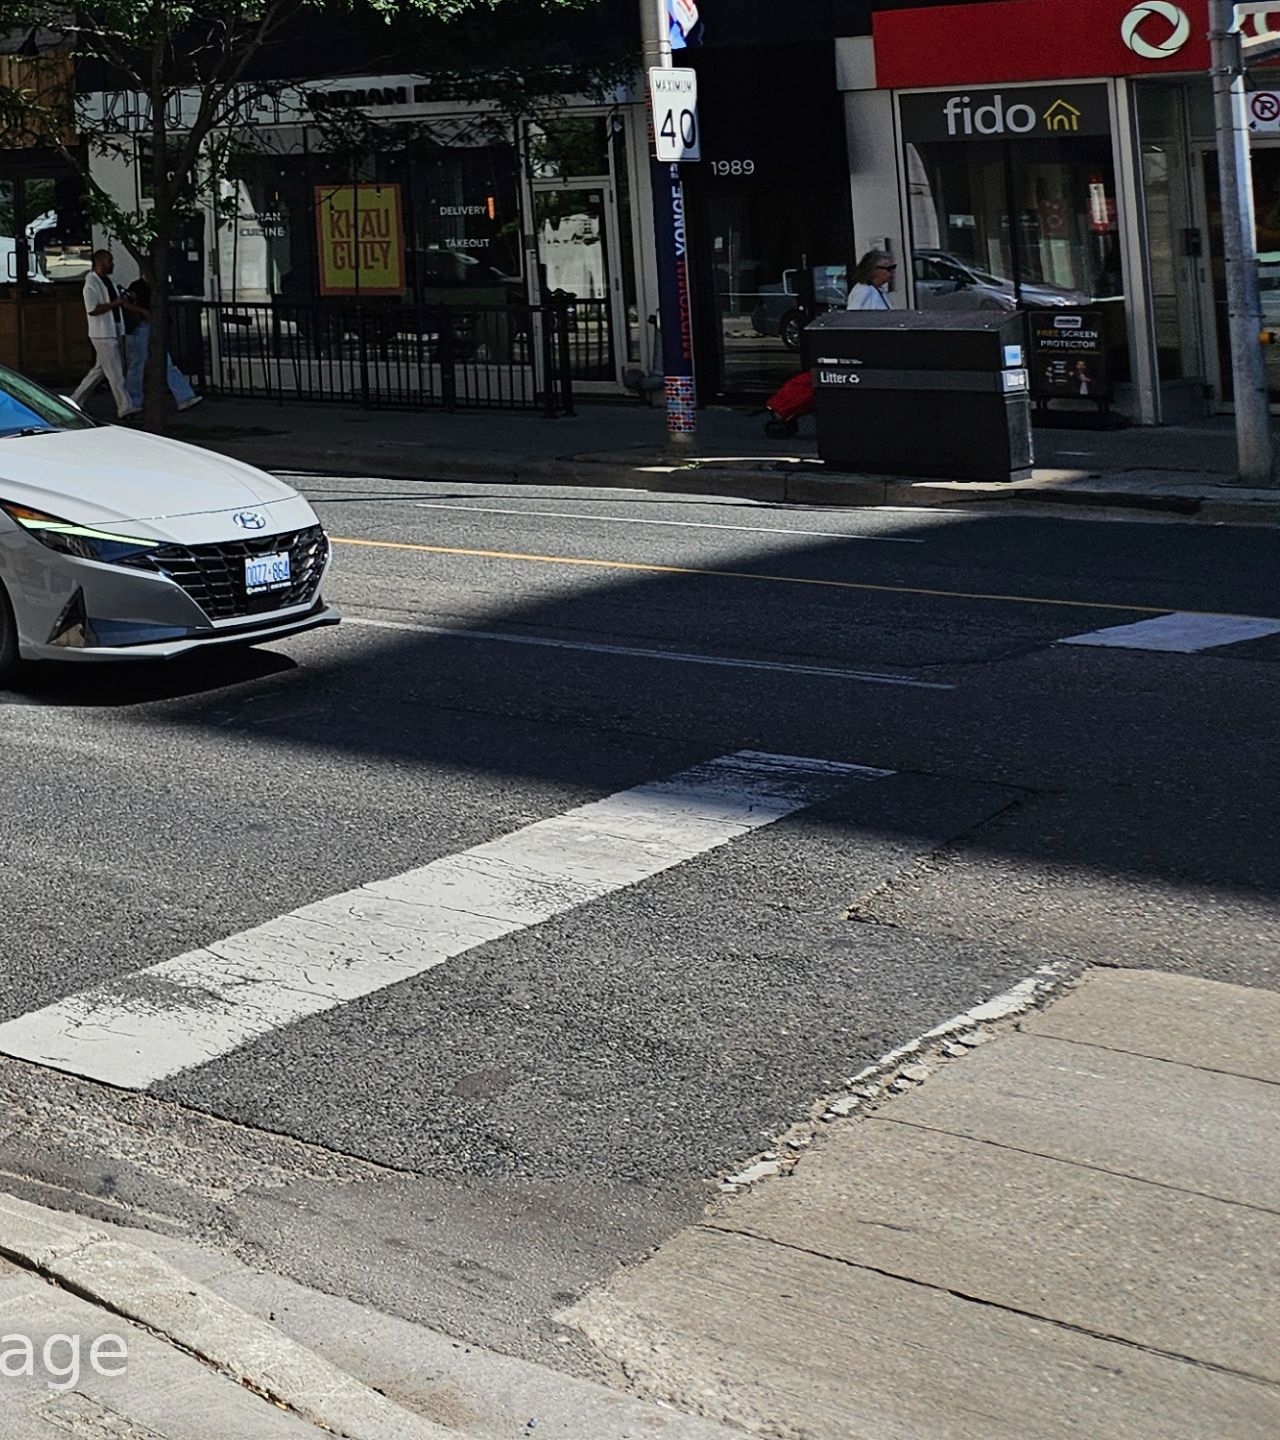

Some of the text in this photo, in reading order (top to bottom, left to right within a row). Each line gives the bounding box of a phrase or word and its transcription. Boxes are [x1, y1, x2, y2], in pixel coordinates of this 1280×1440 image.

[655, 79, 693, 93] MAXIMUM
[943, 95, 1037, 136] fido
[660, 108, 696, 150] 40
[711, 160, 755, 175] 1989
[440, 205, 487, 216] DELIVERY
[330, 209, 391, 240] KHAU
[445, 238, 490, 248] TAKEOUT
[1061, 330, 1098, 338] SCREEN
[1040, 340, 1096, 348] PROTECTOR
[820, 371, 847, 384] Litter
